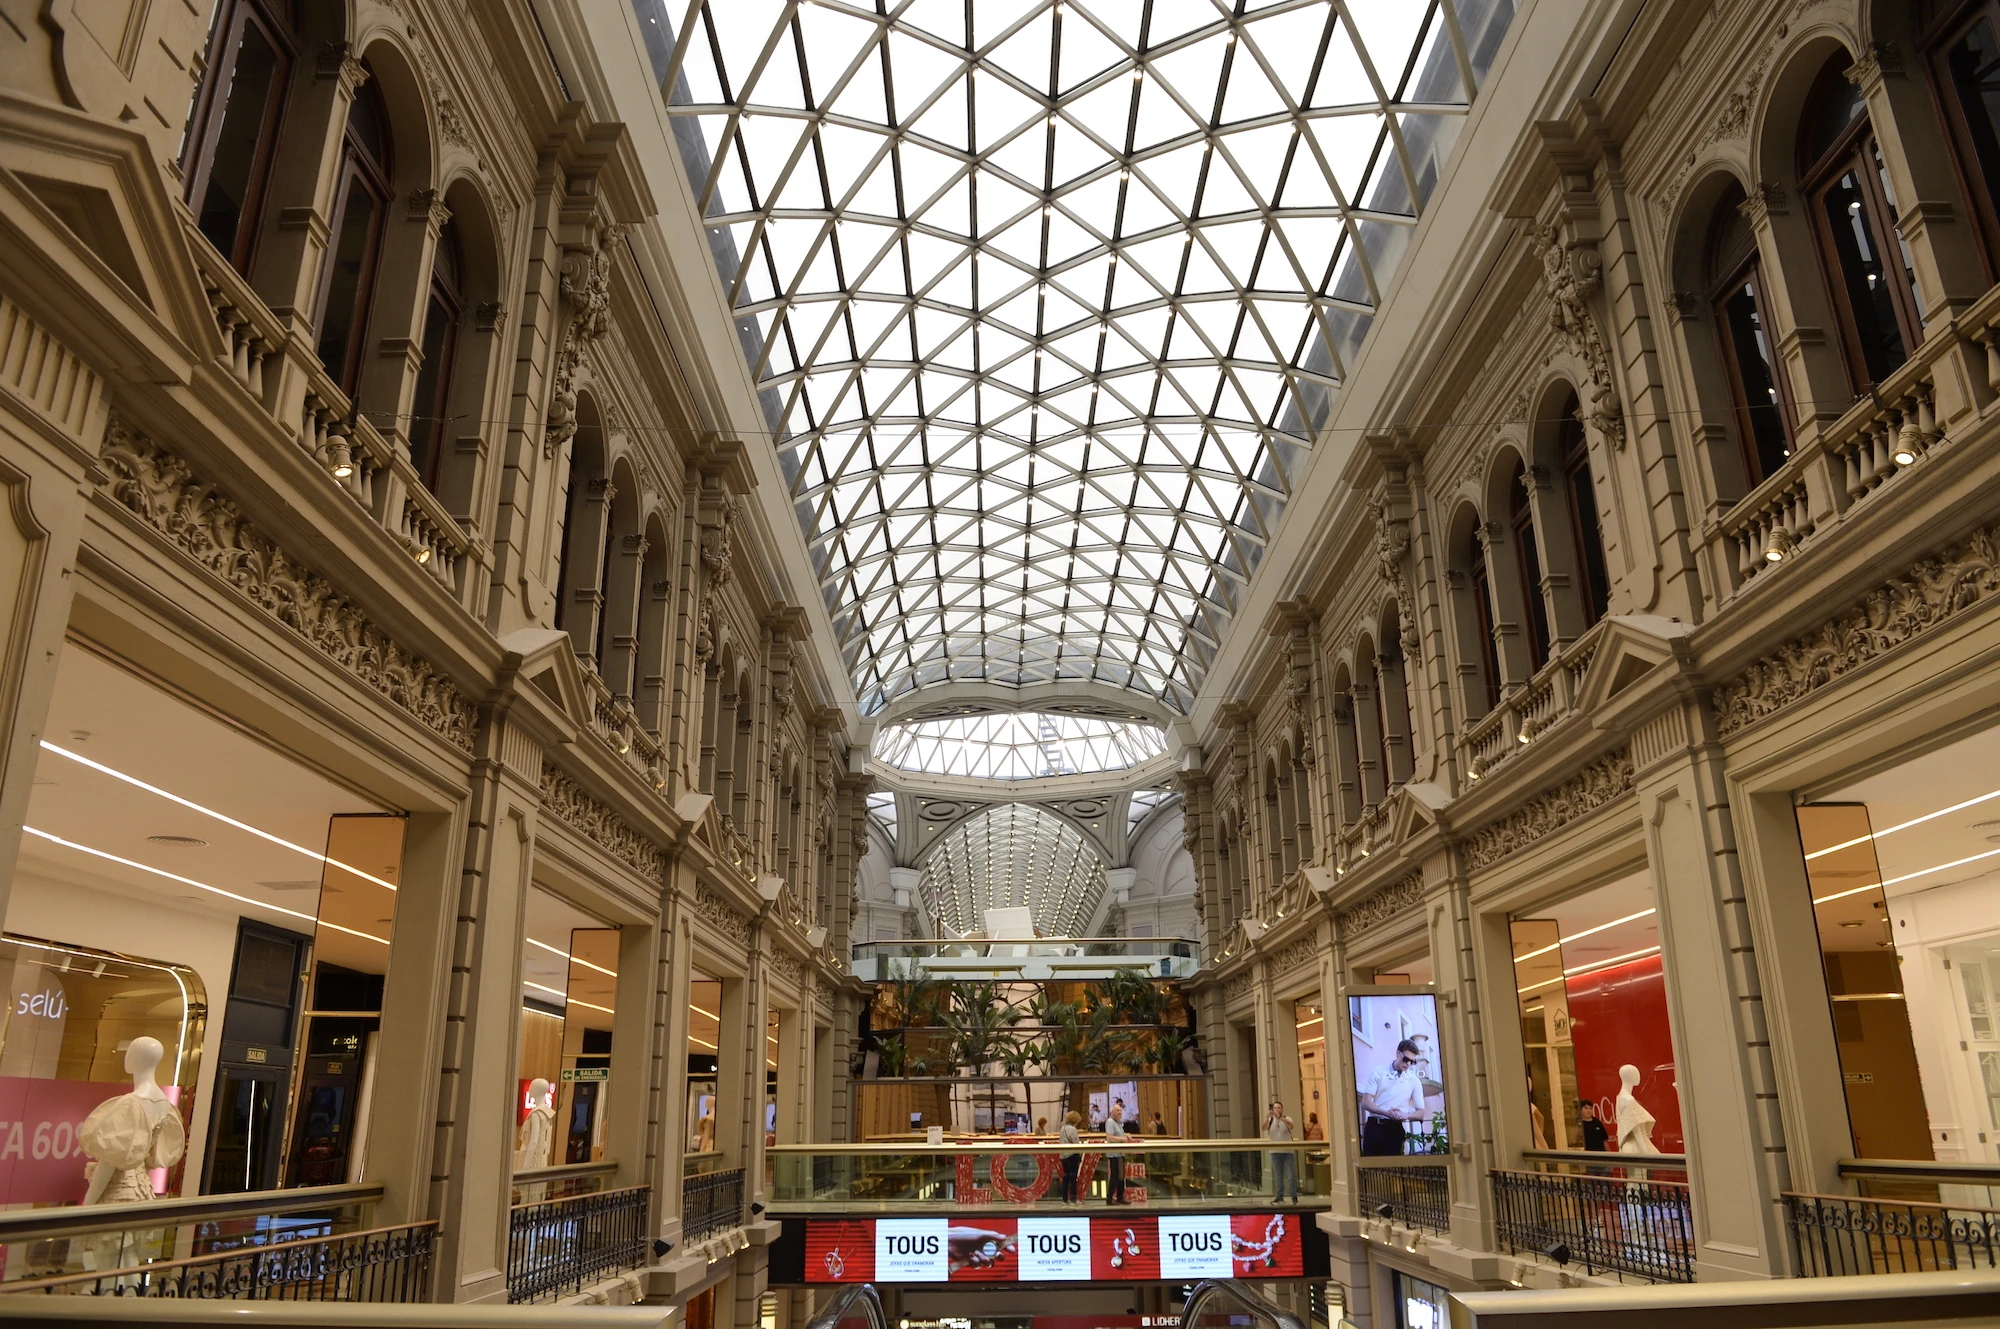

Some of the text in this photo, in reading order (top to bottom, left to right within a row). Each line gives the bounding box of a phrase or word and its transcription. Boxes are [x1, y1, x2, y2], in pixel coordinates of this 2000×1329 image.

[247, 1050, 266, 1061] SALIDA
[885, 1235, 939, 1255] TOUS
[1027, 1234, 1081, 1254] TOUS
[1168, 1232, 1223, 1252] TOUS
